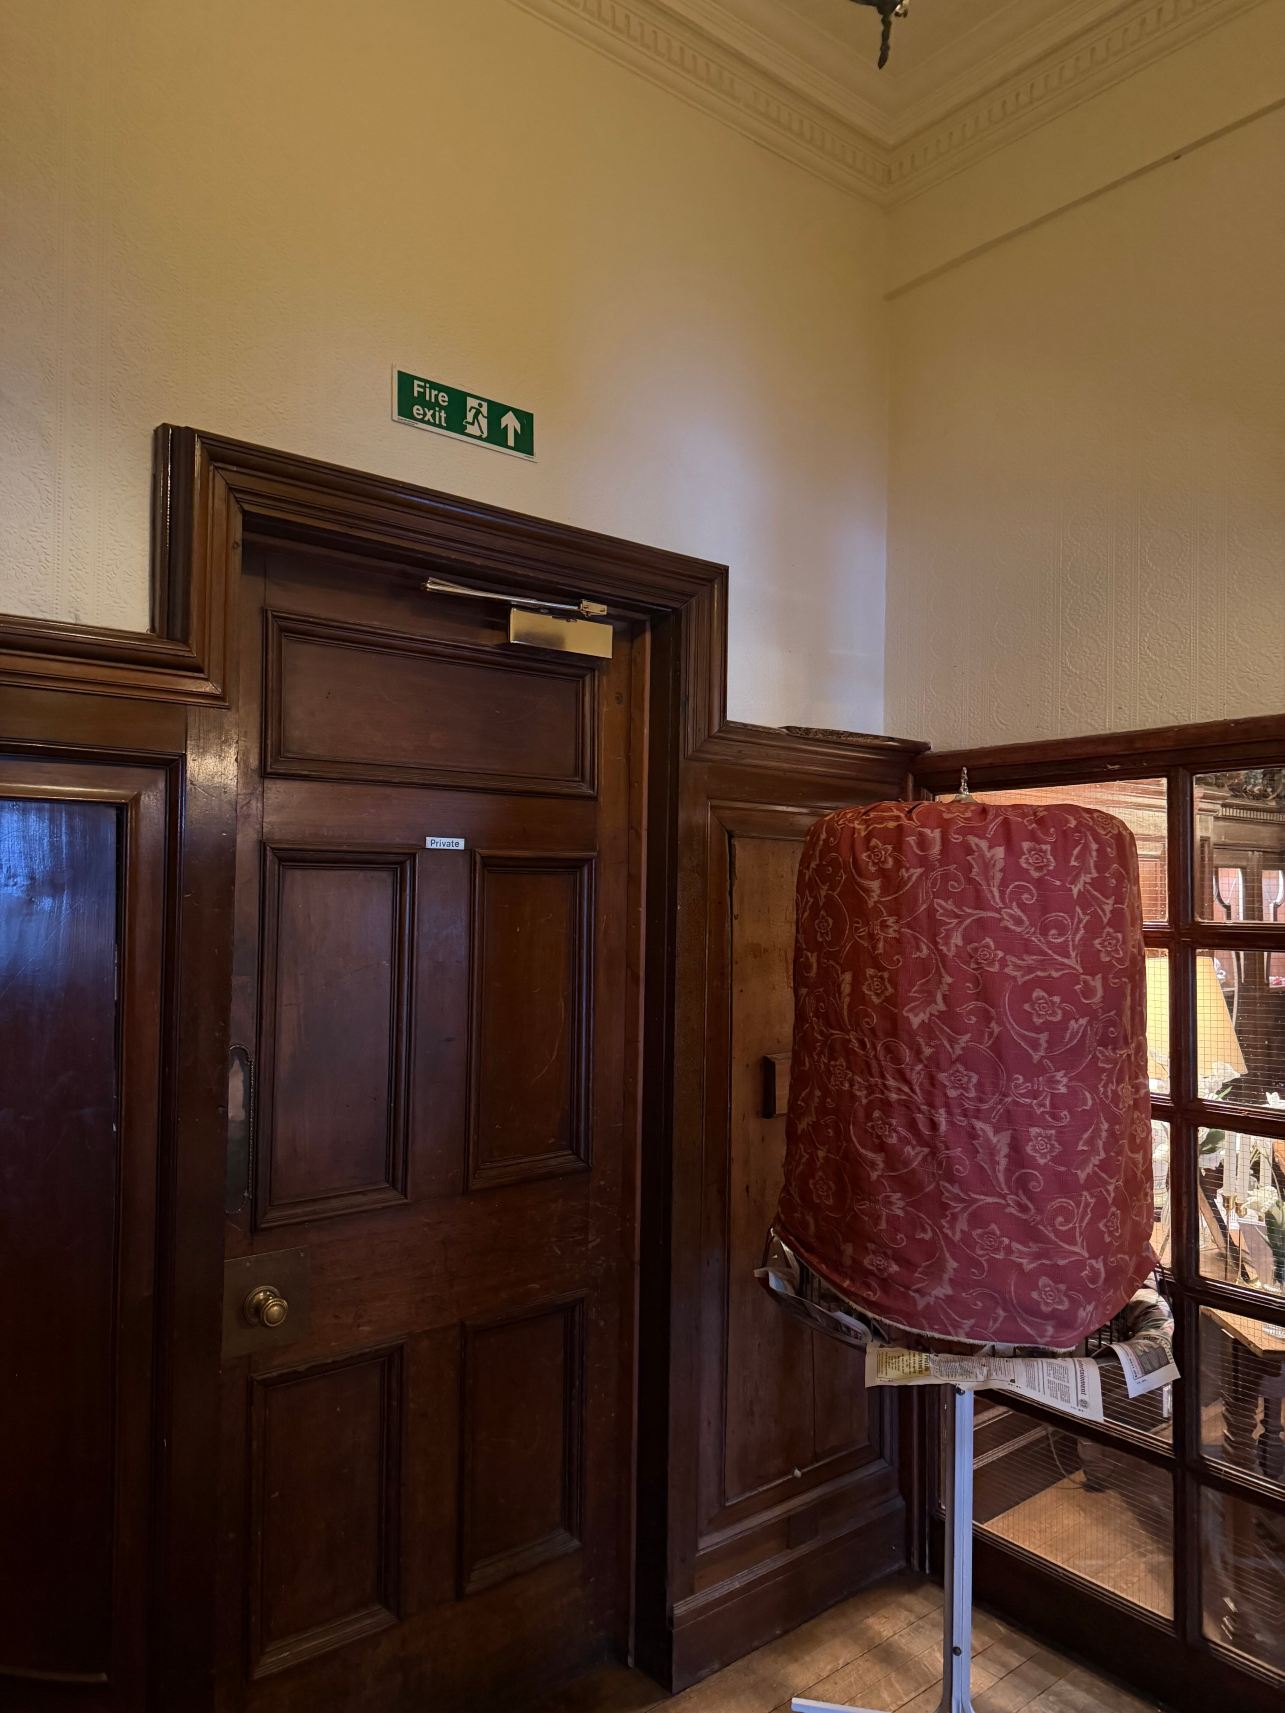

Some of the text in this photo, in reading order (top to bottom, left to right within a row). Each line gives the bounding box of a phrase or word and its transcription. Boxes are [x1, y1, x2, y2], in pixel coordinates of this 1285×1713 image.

[413, 380, 449, 406] Fire
[412, 404, 447, 427] exit
[430, 838, 460, 848] Private
